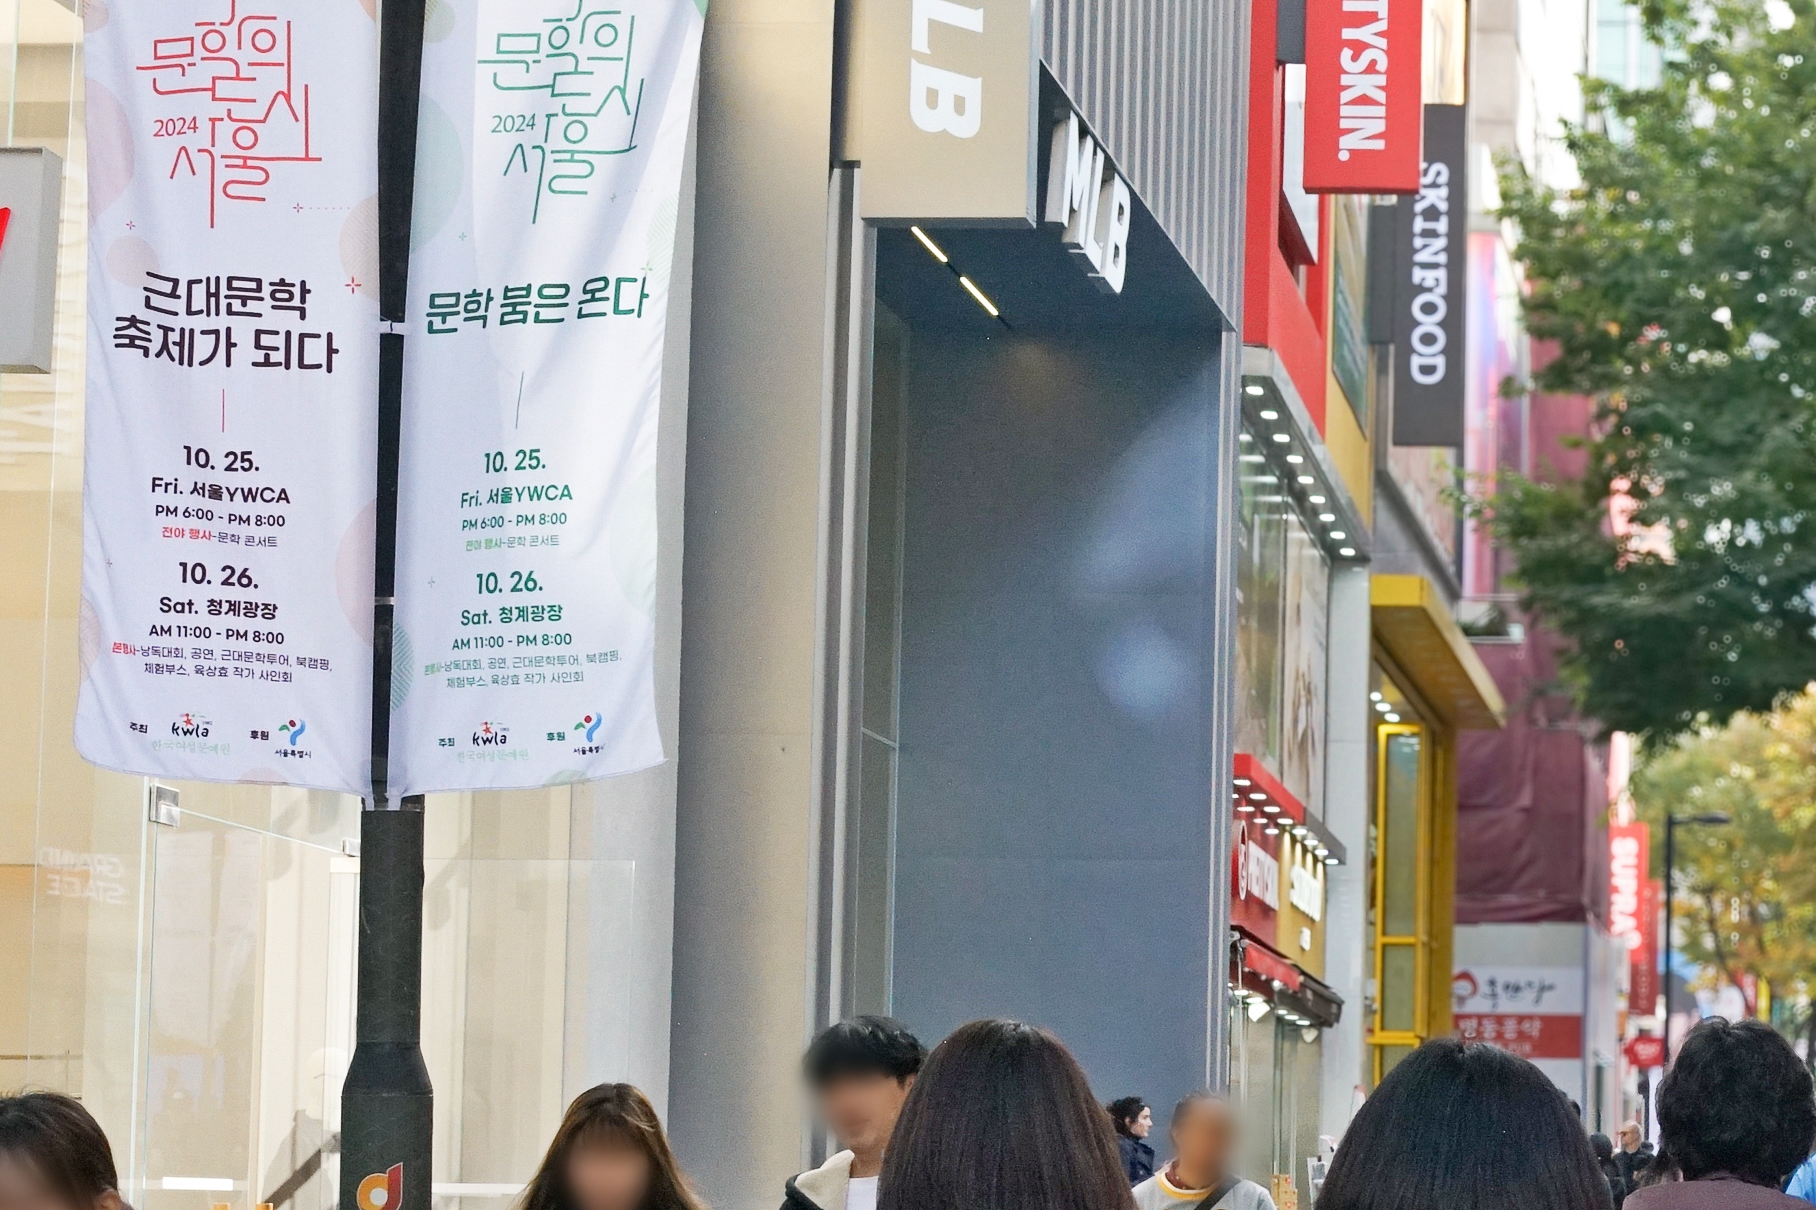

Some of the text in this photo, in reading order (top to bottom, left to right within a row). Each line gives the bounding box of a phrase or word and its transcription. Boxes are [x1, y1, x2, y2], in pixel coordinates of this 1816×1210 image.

[910, 0, 983, 138] LB
[1338, 0, 1389, 161] TYSKIN.
[153, 116, 199, 137] 2024
[491, 113, 536, 133] 2024
[1046, 110, 1131, 294] MLB
[1409, 161, 1450, 386] SKINFOOD
[142, 271, 311, 321] 근대문학
[425, 276, 650, 334] 문학 붐은 온다
[113, 315, 340, 374] 축제가 되다
[183, 445, 260, 472] 10. 25.
[484, 449, 546, 473] 10. 25.
[151, 476, 291, 504] Fri. 서울YWCA
[460, 484, 573, 509] Fri. 서울YWCA
[155, 504, 178, 518] PM
[182, 506, 214, 521] 6:00
[228, 513, 251, 526] PM
[254, 515, 286, 527] 8:00
[461, 518, 478, 531] PM
[480, 516, 505, 529] 6:00
[516, 514, 535, 526] PM
[538, 512, 567, 525] 8:00
[244, 535, 278, 548] 콘서트
[529, 534, 560, 547] 콘서트
[179, 561, 259, 589] 10. 26.
[476, 570, 543, 594] 10. 26.
[159, 596, 278, 620] Sat. 청계광장
[460, 604, 563, 626] Sat. 청계광장
[149, 624, 172, 637] AM
[176, 625, 212, 638] 11:00
[225, 628, 248, 641] PM
[252, 631, 285, 644] 8:00
[452, 637, 470, 650] AM
[473, 635, 504, 649] 11:00
[516, 634, 537, 647] PM
[541, 633, 572, 645] 8:00
[190, 647, 216, 661] 공연,
[221, 649, 292, 668] 근대문학투어,
[233, 667, 255, 680] 작가
[259, 669, 293, 683] 사인회
[524, 672, 546, 684] 작가
[550, 671, 584, 683] 사인회
[171, 722, 209, 738] kwla
[250, 730, 269, 741] 후원
[472, 731, 507, 747] kwla
